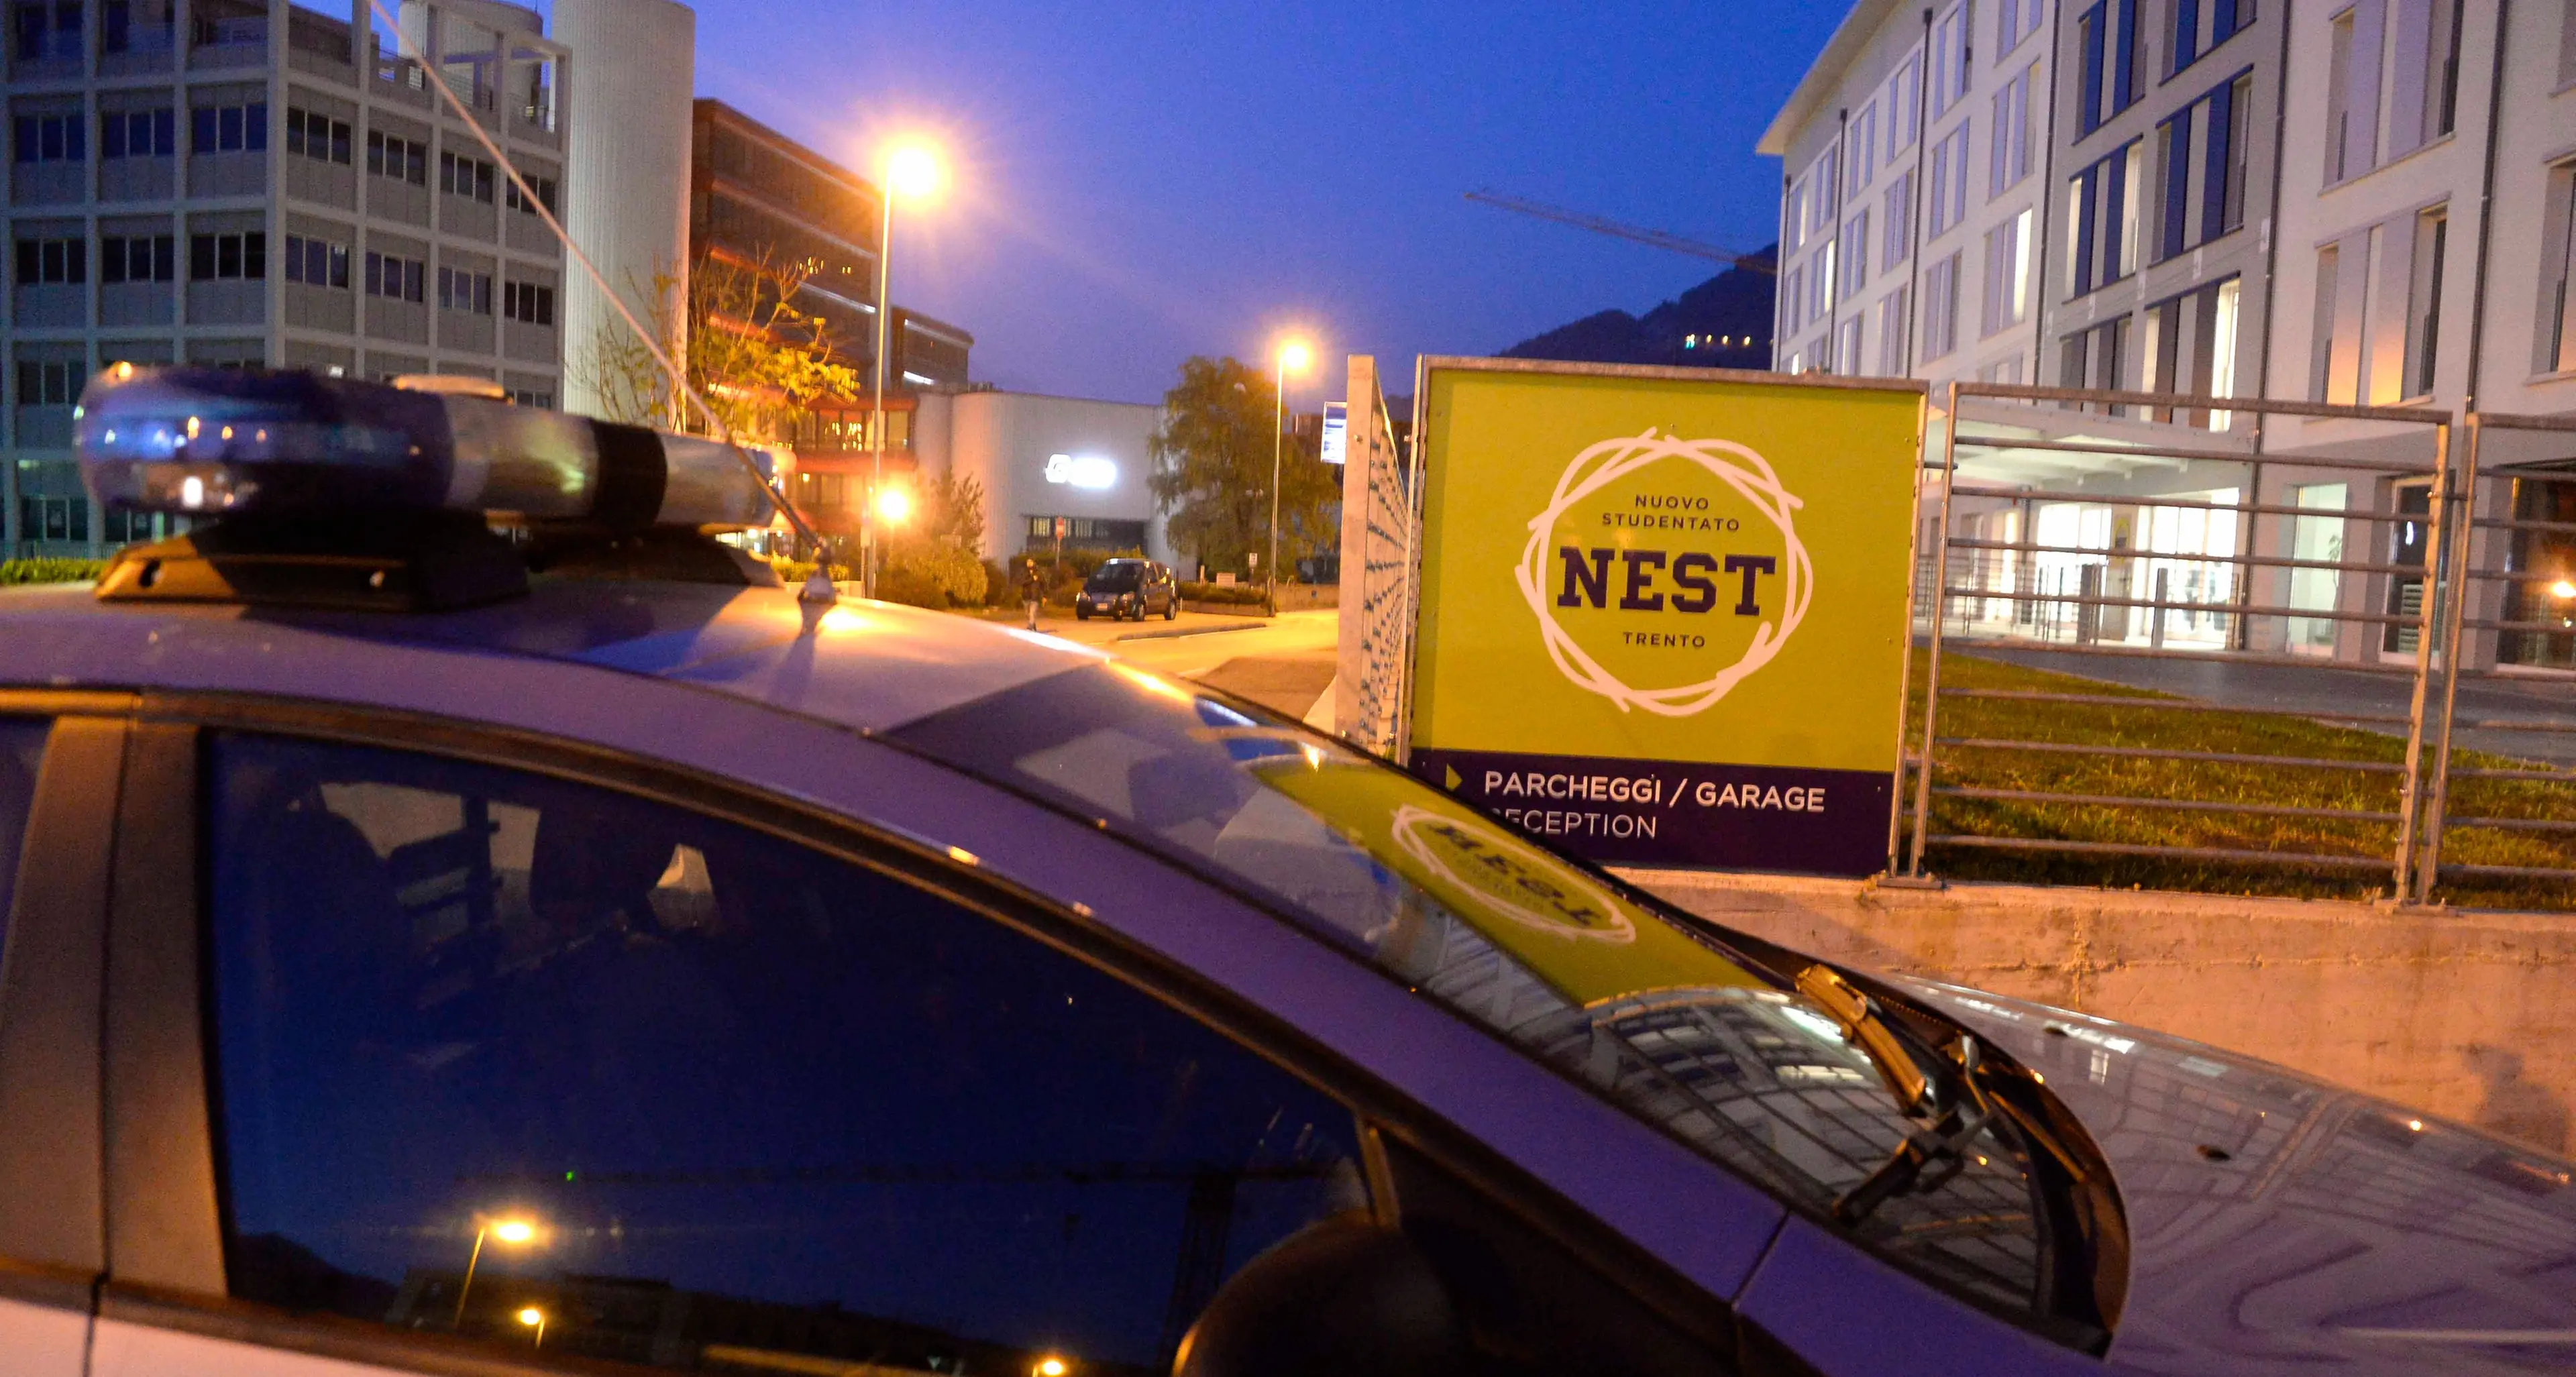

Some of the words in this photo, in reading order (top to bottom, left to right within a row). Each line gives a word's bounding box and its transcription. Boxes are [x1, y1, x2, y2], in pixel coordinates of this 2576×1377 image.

[1635, 494, 1709, 510] NUOVO
[1602, 512, 1740, 531] STUDENTATO
[1556, 545, 1776, 616] NEST
[1623, 631, 1705, 648] TRENTO
[1485, 771, 1661, 804] PARCHEGGI
[1668, 778, 1688, 807] /
[1695, 783, 1825, 812] GARAGE
[1491, 808, 1656, 839] ECEPTION
